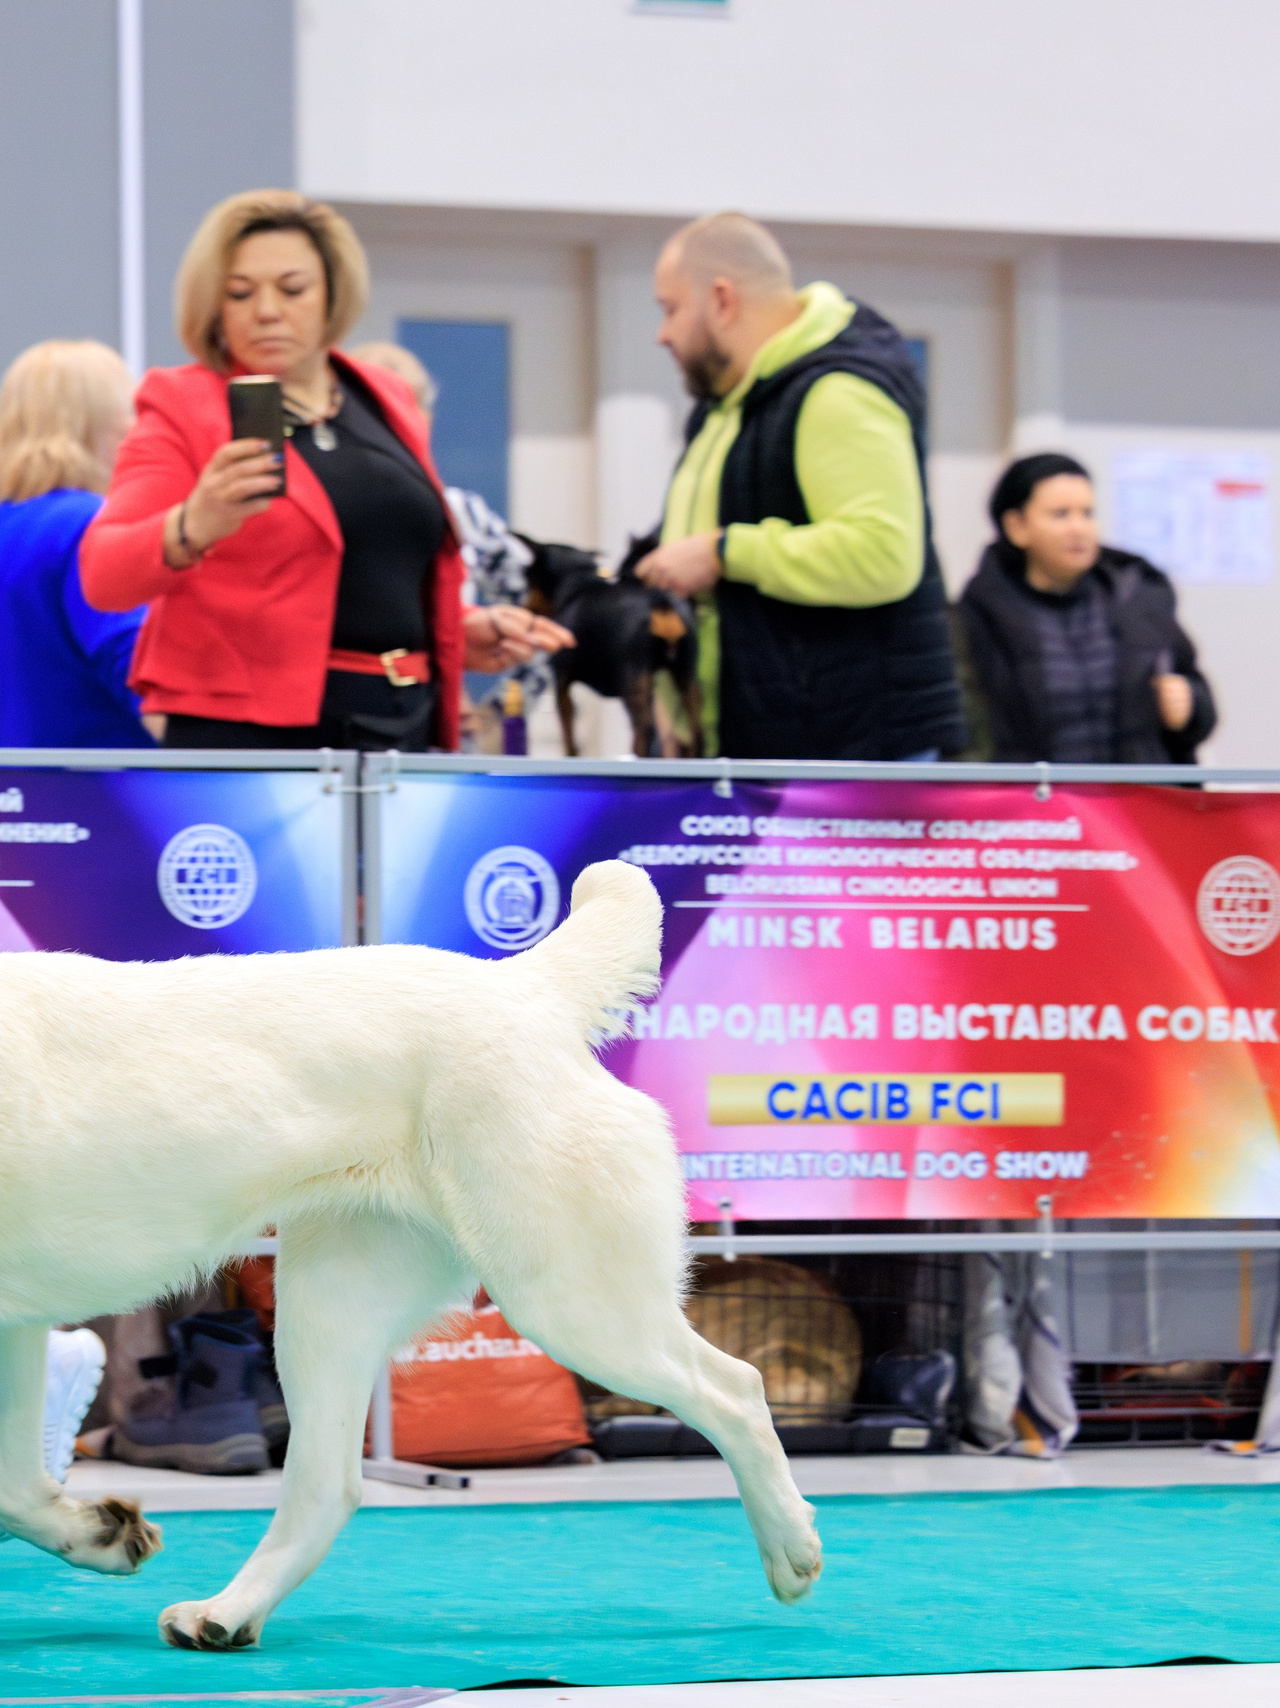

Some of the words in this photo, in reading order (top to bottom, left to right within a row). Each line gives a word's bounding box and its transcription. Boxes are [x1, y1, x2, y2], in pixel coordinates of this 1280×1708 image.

[680, 814, 751, 837] СОЮЗ
[989, 877, 1059, 898] UNION
[708, 916, 843, 949] MINSK
[870, 916, 1058, 951] BELARUS
[892, 1003, 1128, 1042] ВЫСТАВКА
[1136, 1005, 1280, 1043] СОБАК
[767, 1081, 912, 1121] CACIB
[931, 1082, 1001, 1121] FCI
[915, 1150, 989, 1180] DOG
[994, 1150, 1089, 1180] SHOW
